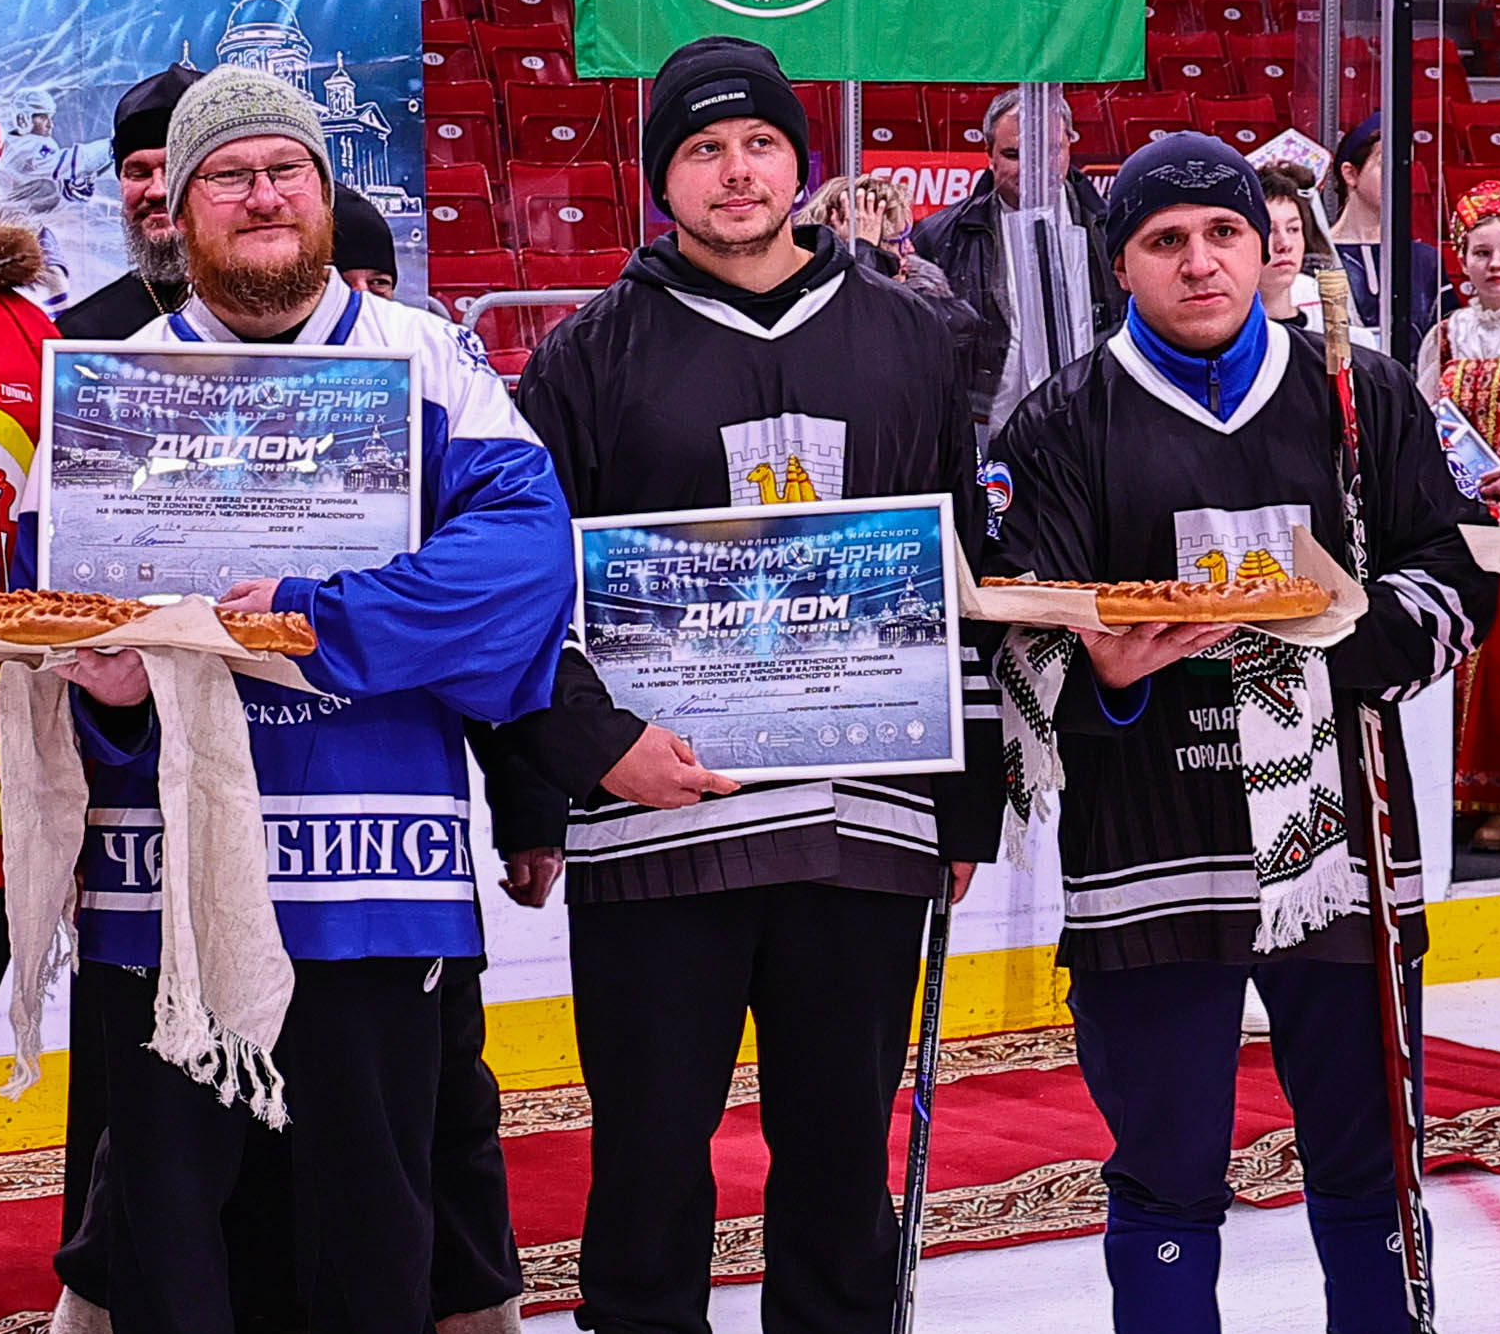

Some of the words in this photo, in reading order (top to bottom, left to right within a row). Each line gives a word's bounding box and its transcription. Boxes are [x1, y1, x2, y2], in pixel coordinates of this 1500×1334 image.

[76, 385, 257, 407] СРЕТЕНСКИЙ
[283, 389, 389, 409] ТУРНИР
[149, 433, 318, 462] ДИПЛОМ
[606, 550, 786, 579] СРЕТЕНСКИЙ
[814, 541, 922, 566] ТУРНИР
[678, 594, 851, 631] ДИПЛОМ
[1188, 706, 1235, 733] ЧЕЛЯ
[102, 819, 472, 887] ЧЕБИНСК
